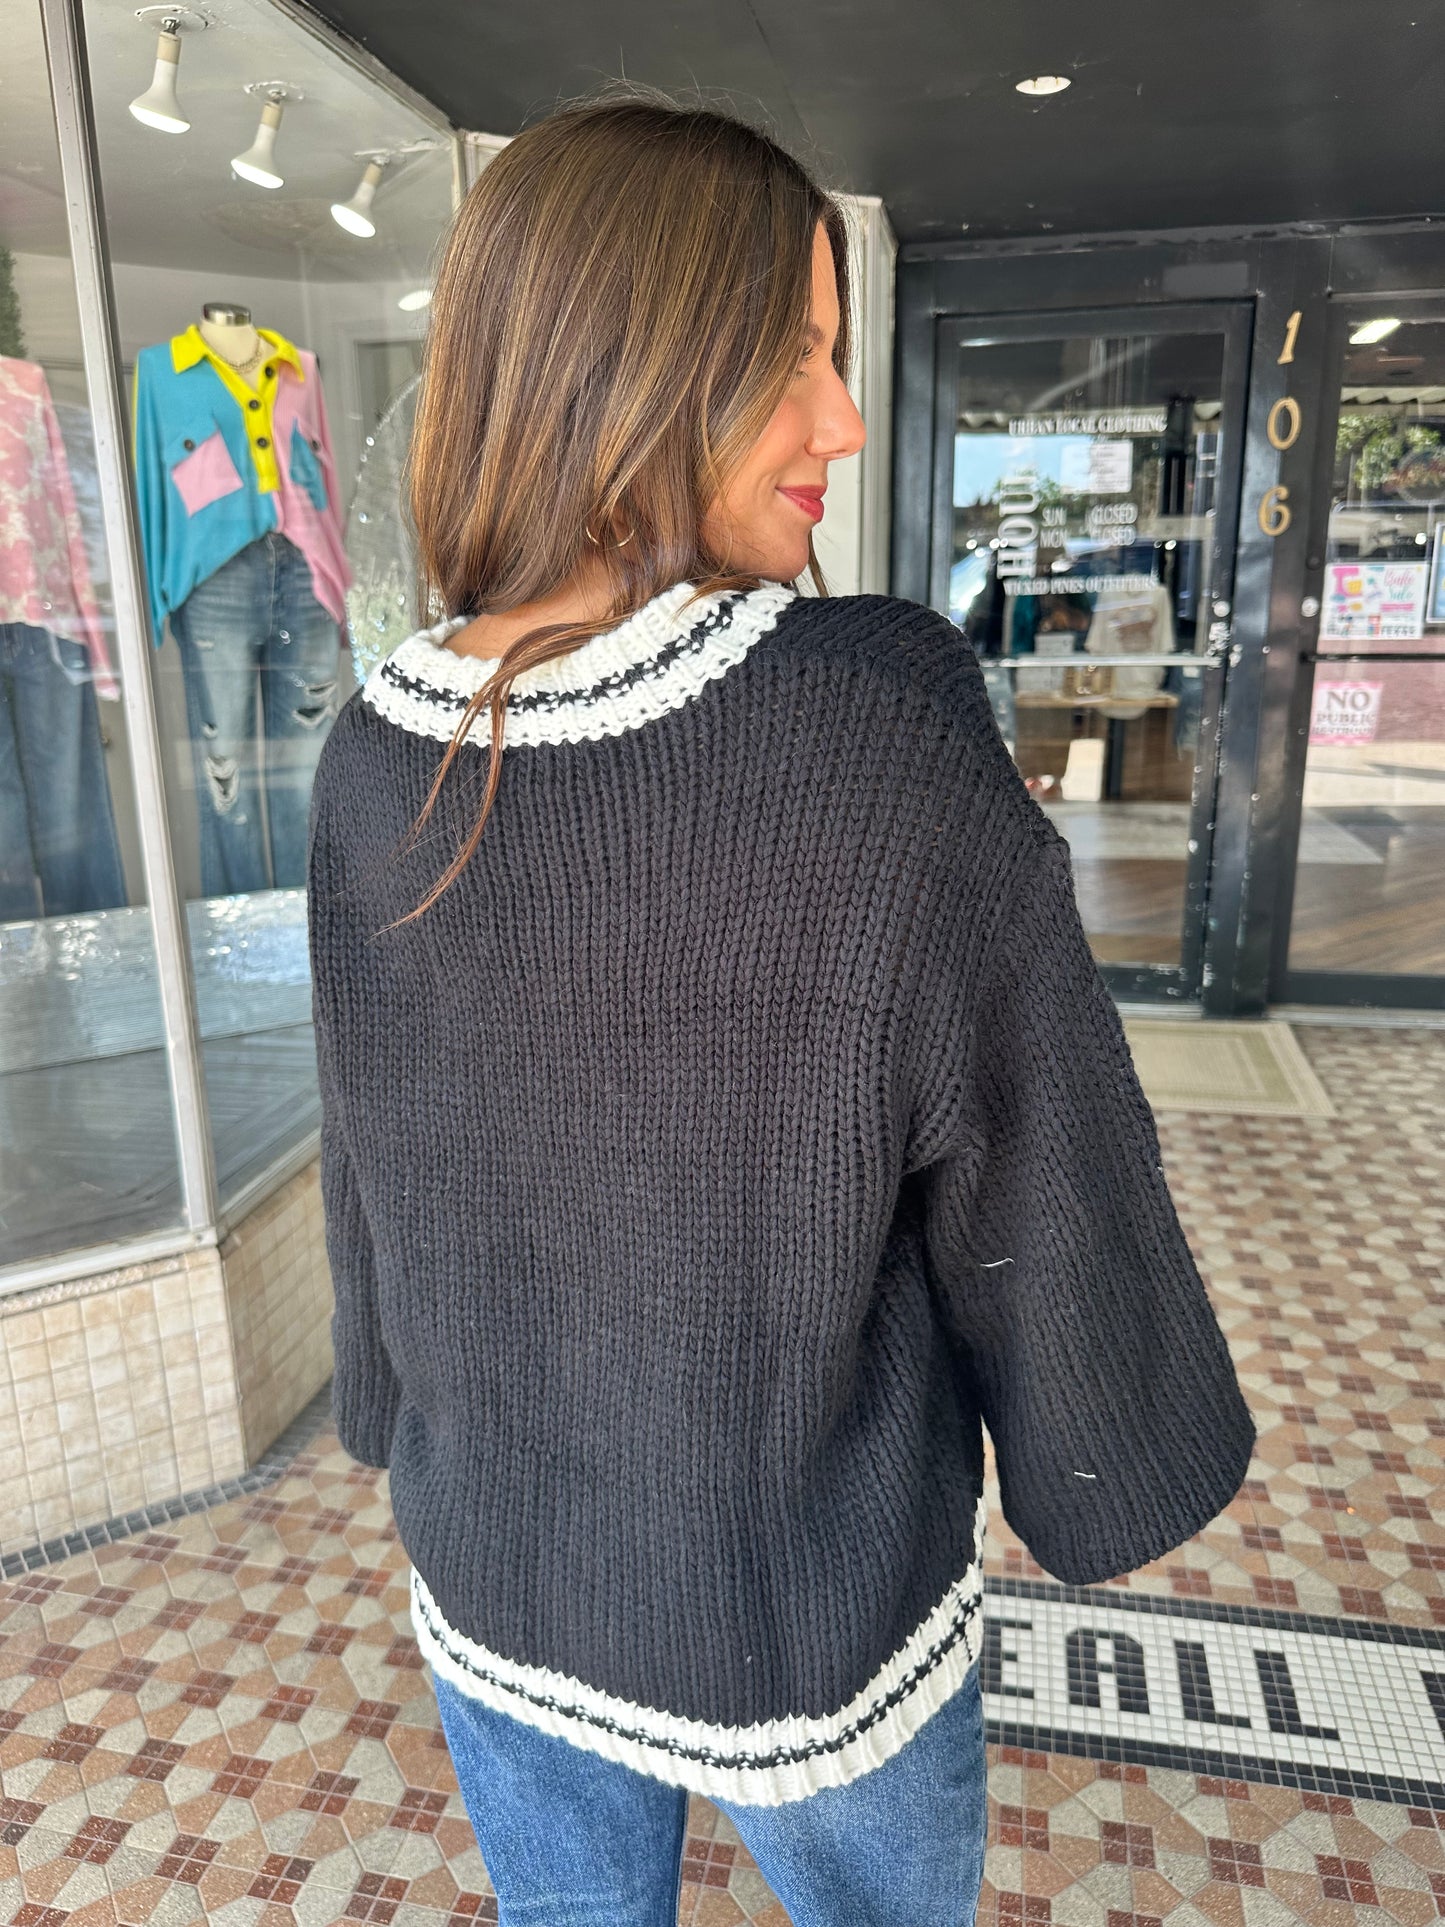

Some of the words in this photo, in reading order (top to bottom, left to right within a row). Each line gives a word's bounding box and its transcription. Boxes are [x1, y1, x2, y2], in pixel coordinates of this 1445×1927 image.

[1098, 414, 1168, 432] CLOTHING
[1258, 310, 1302, 537] 106
[1042, 506, 1067, 527] SUN
[1091, 502, 1138, 525] CLOSED
[1040, 529, 1067, 548] MON
[1326, 690, 1371, 711] NO
[1317, 712, 1376, 727] PUBLIC
